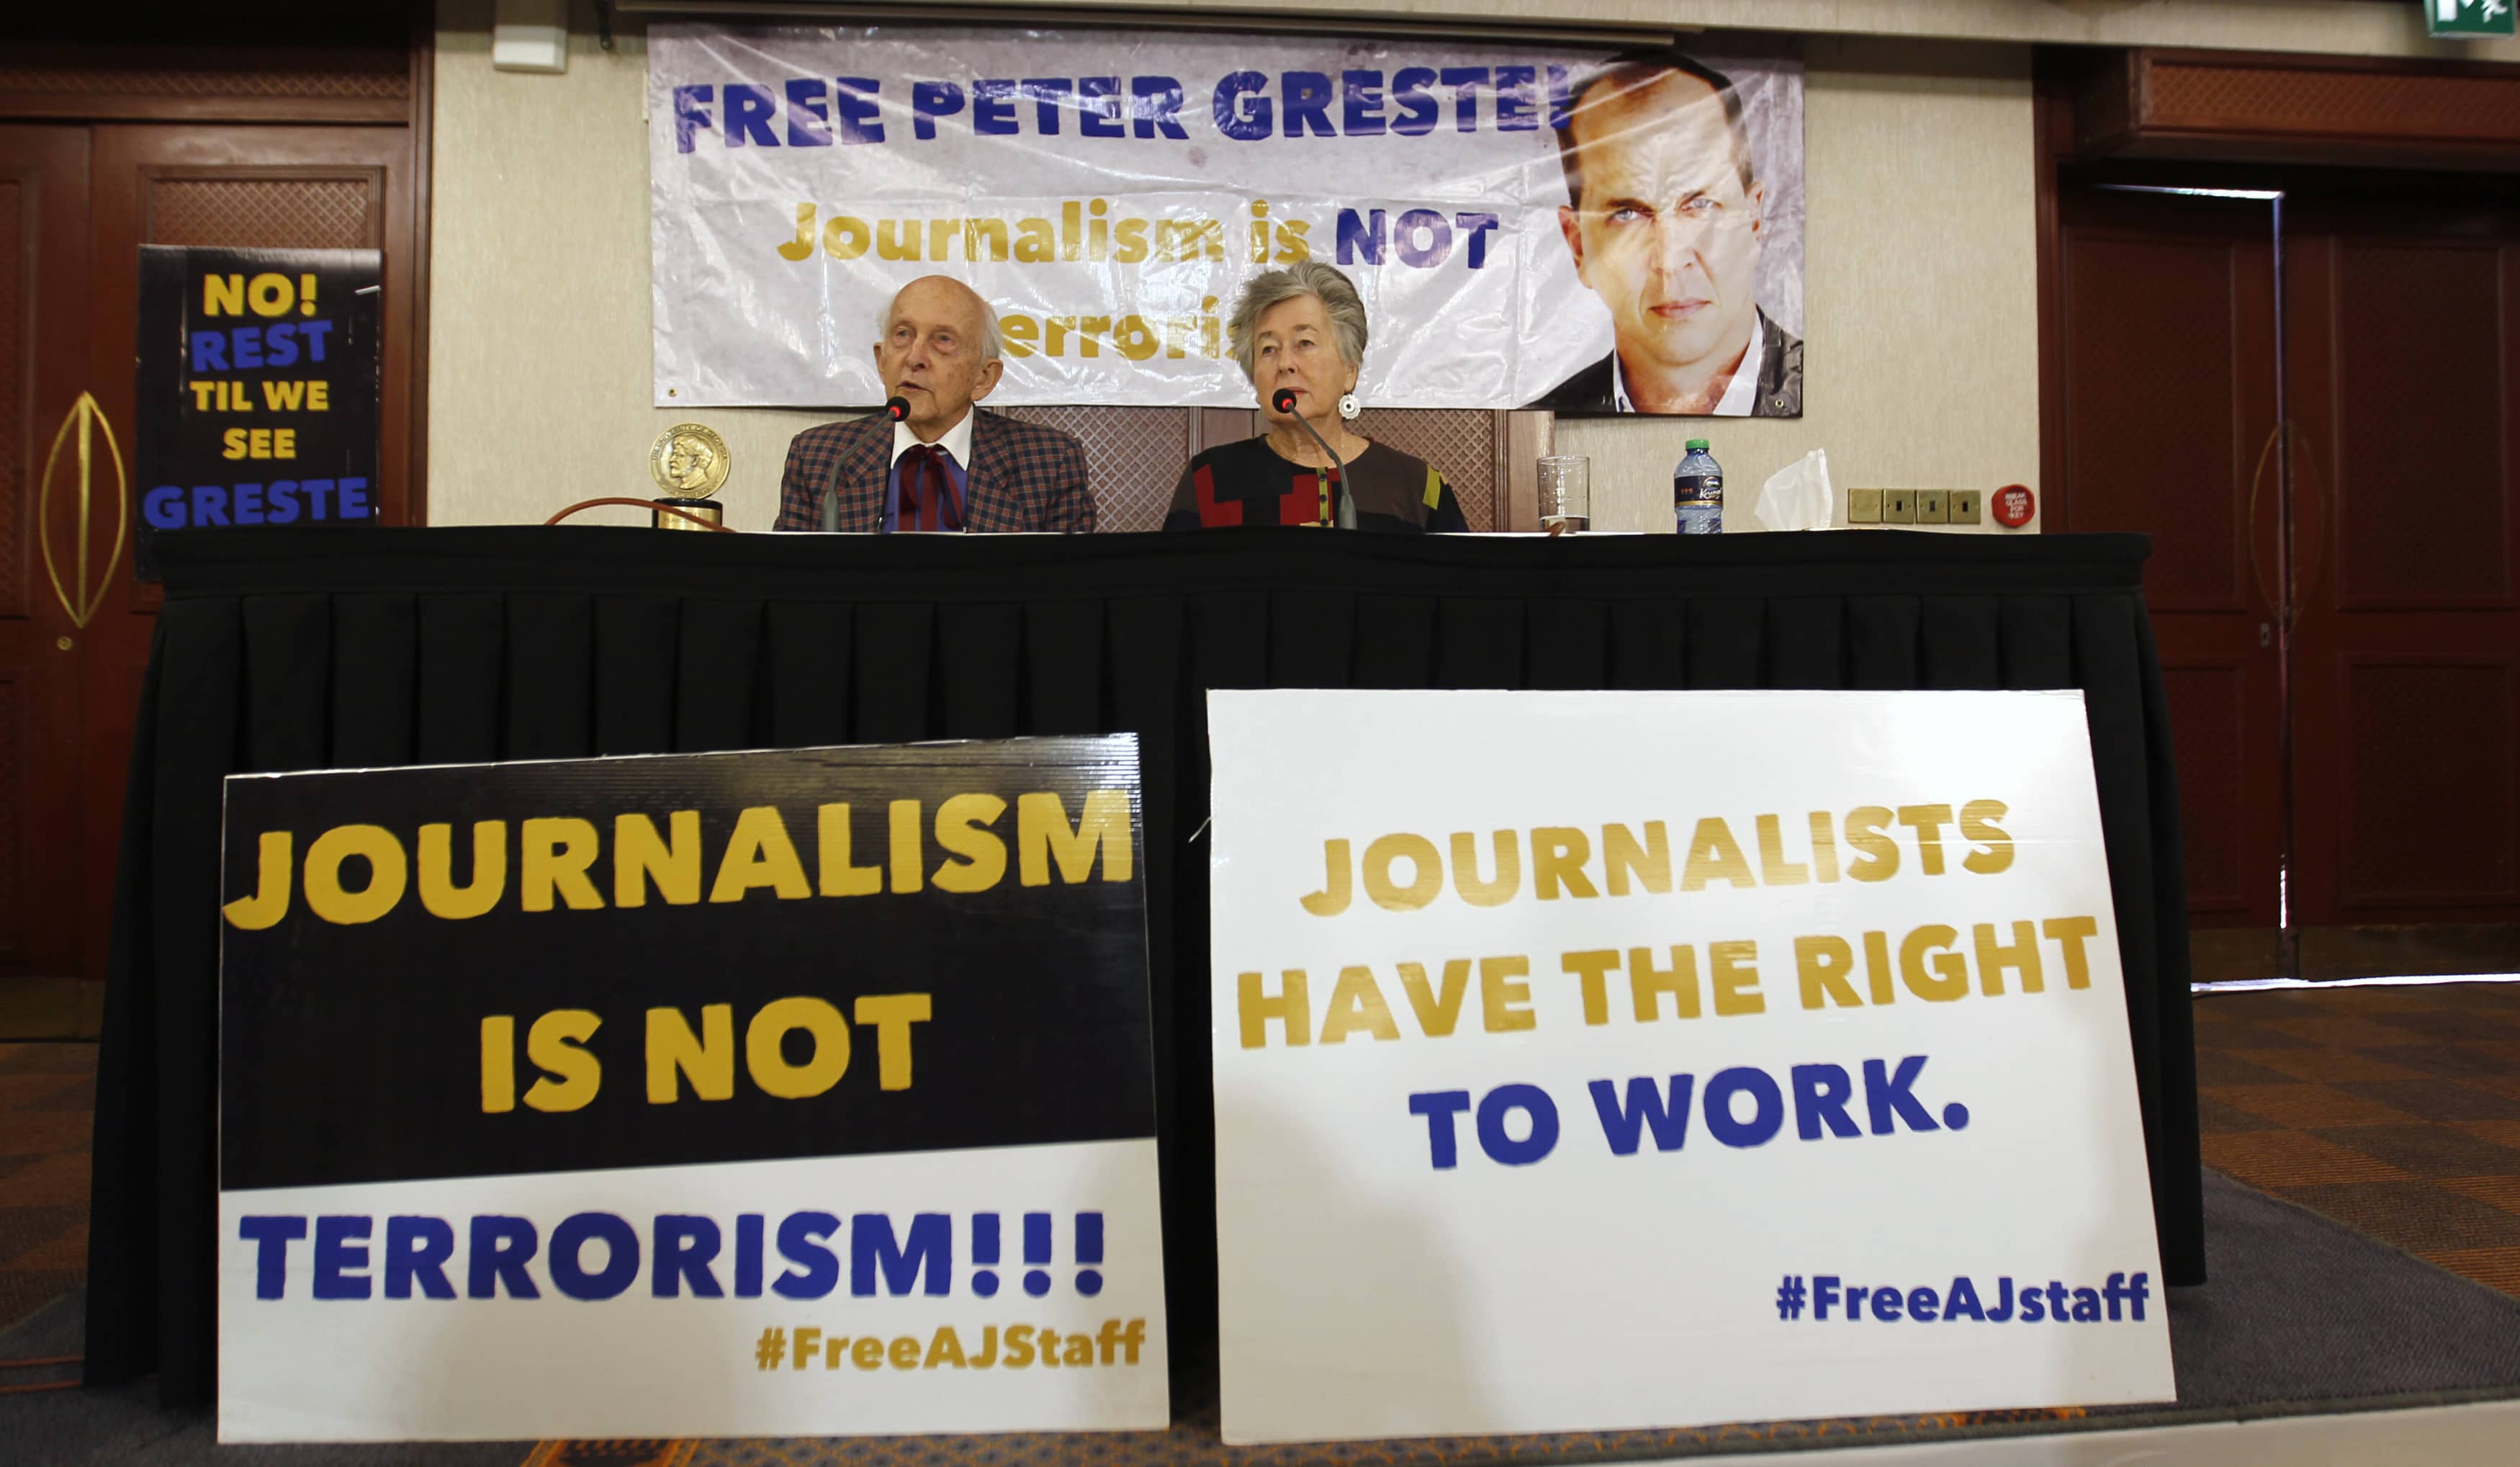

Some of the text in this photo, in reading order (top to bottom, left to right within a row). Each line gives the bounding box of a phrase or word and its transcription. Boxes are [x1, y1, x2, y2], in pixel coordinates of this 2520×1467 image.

[673, 64, 1570, 154] FREE PETER GRESTE!
[778, 198, 1498, 269] Journalism is NOT
[204, 273, 318, 317] NO!
[190, 320, 333, 372] REST
[190, 380, 329, 411] TIL WE
[222, 428, 297, 459] SEE
[143, 477, 370, 529] GRESTE
[222, 791, 1133, 930] JOURNALISM
[1300, 799, 2015, 917] JOURNALISTS
[1238, 915, 2098, 1050] HAVE THE RIGHT
[481, 994, 932, 1113] IS NOT
[1409, 1055, 1970, 1170] TO WORK.
[239, 1211, 1104, 1301] TERRORISM!!!
[1776, 1273, 2150, 1322] #FreeAJstaff
[756, 1319, 1146, 1370] #FreeAJStaff
